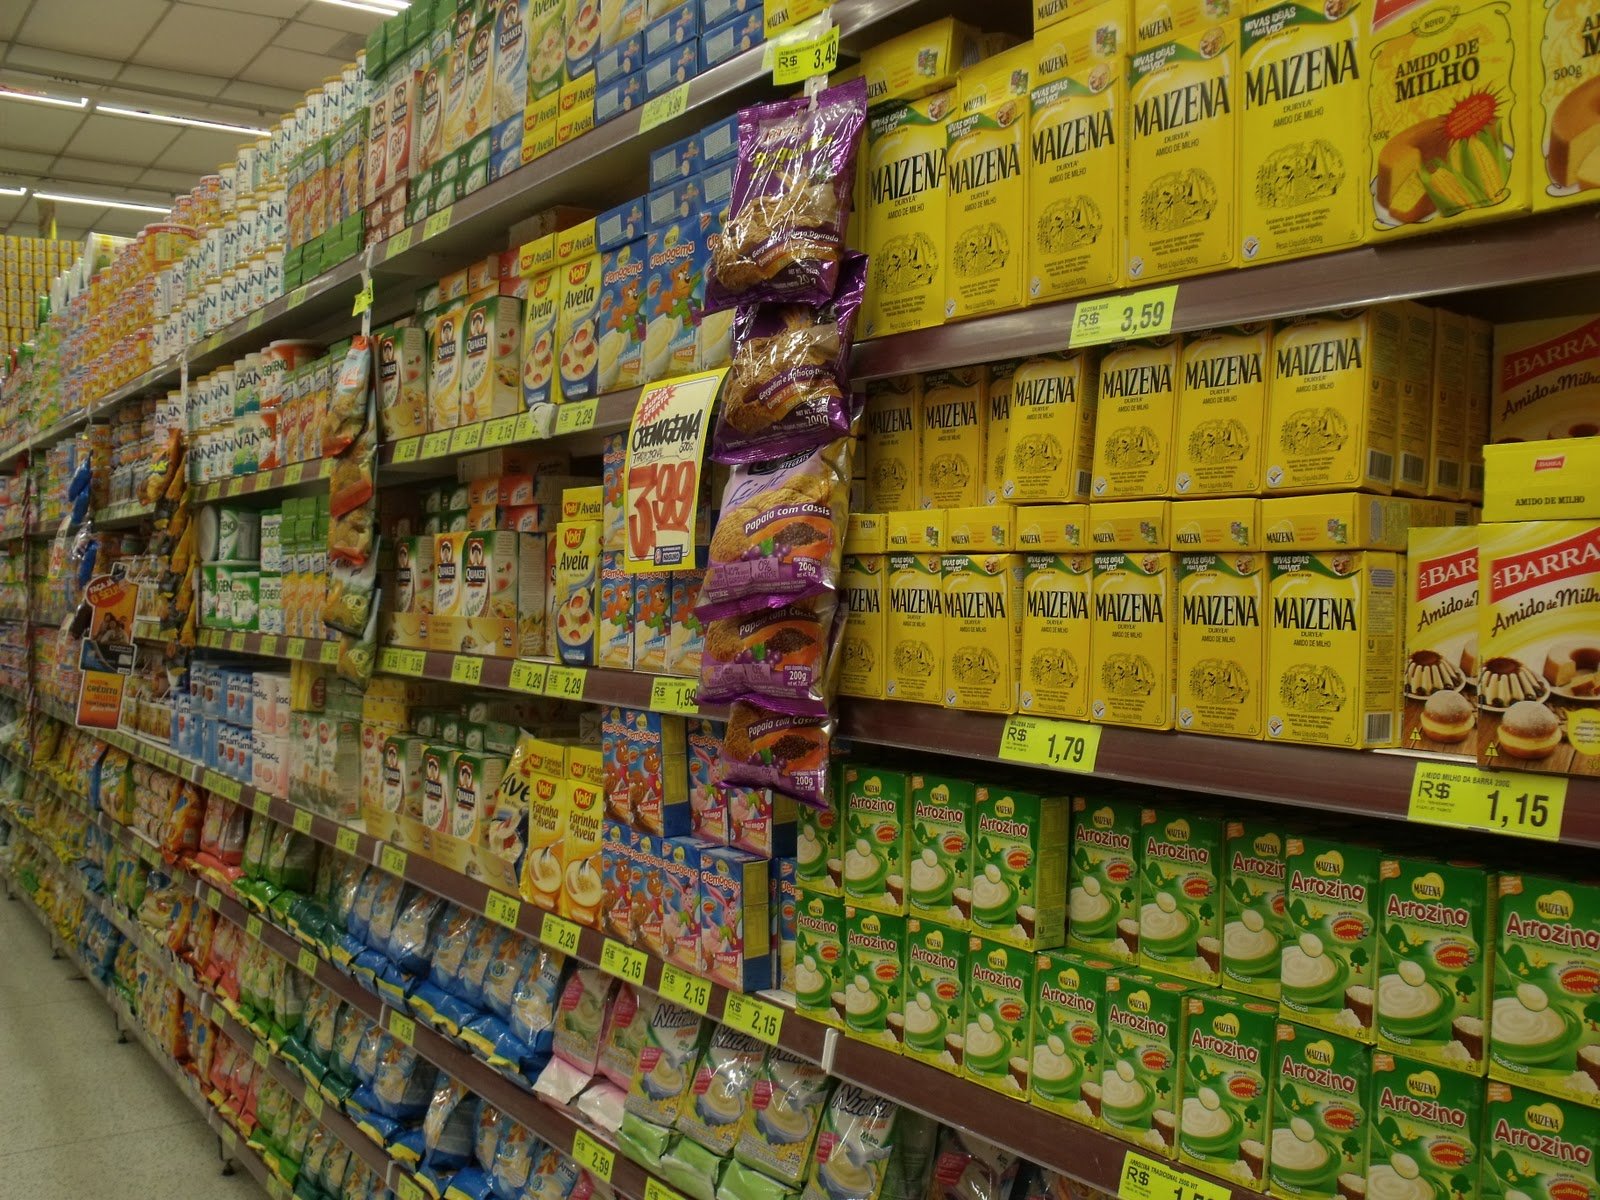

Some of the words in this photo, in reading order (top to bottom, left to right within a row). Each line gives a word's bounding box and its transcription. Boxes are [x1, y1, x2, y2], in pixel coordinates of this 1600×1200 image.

[767, 8, 789, 29] MAIZENA
[1138, 17, 1172, 41] MAIZENA
[500, 27, 522, 46] QUAKER
[469, 51, 488, 70] QUAKER
[779, 56, 797, 68] R$
[814, 41, 836, 69] 3,49
[1038, 54, 1068, 76] MAIZENA
[1395, 46, 1451, 79] AMIDO
[1454, 38, 1479, 62] DE
[1246, 38, 1360, 110] MAIZENA
[1395, 56, 1480, 103] MILHO
[1553, 63, 1583, 82] 500g
[538, 107, 557, 123] Aveia
[1133, 75, 1230, 140] MAIZENA
[1272, 113, 1292, 128] AMIDO
[1293, 113, 1302, 123] DE
[1304, 107, 1324, 120] MILHO
[573, 116, 592, 132] Aveia
[536, 136, 554, 153] Aveia
[1032, 108, 1115, 168] MAIZENA
[1372, 129, 1390, 142] 500g
[870, 147, 948, 207] MAIZENA
[949, 143, 1021, 197] MAIZENA
[574, 235, 593, 251] Aveia
[534, 250, 552, 264] Aveia
[563, 286, 594, 311] Aveia
[529, 300, 552, 322] Aveia
[1078, 312, 1100, 328] R$
[1120, 300, 1165, 334] 3,59
[467, 334, 487, 352] QUAKER
[1276, 337, 1362, 379] MAIZENA
[1512, 332, 1592, 379] BARRA
[1102, 365, 1172, 399] MAIZENA
[1185, 352, 1263, 392] MAIZENA
[1015, 376, 1075, 407] MAIZENA
[1501, 386, 1549, 422] Amido
[575, 408, 593, 427] 2,29
[806, 415, 829, 427] 200g
[869, 407, 912, 435] MAIZENA
[925, 401, 977, 430] MAIZENA
[498, 425, 512, 440] 2,15
[632, 409, 703, 452] CREMOGEMA
[580, 502, 601, 515] Aveia
[1515, 498, 1543, 506] AMIDO
[1544, 497, 1556, 505] DE
[1558, 496, 1585, 504] MILHO
[745, 511, 774, 533] Papaia
[778, 507, 798, 515] com
[802, 504, 830, 515] Cassis
[890, 533, 908, 545] MAIZENA
[951, 533, 970, 545] MAIZENA
[1020, 532, 1041, 544] MAIZENA
[1092, 532, 1115, 543] MAIZENA
[1176, 532, 1201, 544] MAIZENA
[1266, 531, 1294, 544] MAIZENA
[559, 551, 589, 571] Aveia
[758, 561, 771, 572] 0%
[798, 562, 816, 573] 200g
[1428, 557, 1478, 586] BAR
[1503, 545, 1600, 588] BARRA
[466, 567, 486, 582] QUAKER
[890, 589, 942, 614] MAIZENA
[944, 592, 1005, 619] MAIZENA
[1026, 590, 1089, 619] MAIZENA
[1095, 593, 1164, 623] MAIZENA
[1182, 595, 1259, 627] MAIZENA
[1273, 597, 1357, 631] MAIZENA
[1417, 600, 1463, 632] Amido
[1463, 598, 1474, 608] de
[1491, 600, 1545, 638] Amido
[1546, 600, 1558, 611] de
[1293, 639, 1309, 647] AMIDO
[1316, 640, 1331, 648] MILHO
[465, 665, 479, 680] 2,15
[525, 672, 542, 688] 2,29
[789, 670, 807, 681] 200g
[564, 677, 581, 695] 2,29
[654, 687, 665, 697] R$
[748, 720, 773, 737] Papaia
[1006, 727, 1027, 742] R$
[1048, 734, 1085, 763] 1,79
[500, 773, 529, 798] Ave
[795, 776, 813, 785] 200g
[457, 789, 475, 802] QUAKER
[574, 789, 593, 808] Yoki
[850, 794, 896, 813] Arrozina
[1418, 780, 1451, 800] R$
[1486, 789, 1549, 829] 1,15
[532, 802, 559, 819] Farinha
[569, 811, 599, 830] Farinha
[915, 801, 963, 823] Arrozina
[537, 816, 556, 831] Aveia
[575, 827, 596, 842] Aveia
[979, 813, 1028, 838] Arrozina
[1076, 824, 1130, 850] Arrozina
[1147, 838, 1210, 865] Arrozina
[1255, 844, 1279, 856] MAIZENA
[1315, 858, 1341, 875] MAIZENA
[1291, 870, 1366, 902] Arrozina
[1413, 883, 1441, 899] MAIZENA
[500, 906, 516, 923] 3,99
[1387, 894, 1470, 927] Arrozina
[1537, 902, 1570, 920] MAIZENA
[798, 912, 837, 935] Arrozina
[1506, 912, 1600, 949] Arrozina
[558, 930, 576, 949] 2,29
[848, 929, 897, 951] Arrozina
[604, 948, 616, 960] R$
[622, 957, 641, 979] 2,15
[911, 945, 957, 970] Arrozina
[973, 963, 1023, 990] Arrozina
[1059, 976, 1079, 989] MAIZENA
[663, 973, 676, 984] R$
[684, 982, 706, 1006] 2,15
[1041, 983, 1095, 1013] Arrozina
[1128, 998, 1150, 1012] MAIZENA
[728, 1000, 742, 1013] R$
[751, 1010, 776, 1036] 2,15
[1110, 1004, 1168, 1037] Arrozina
[1214, 1021, 1239, 1035] MAIZENA
[1192, 1028, 1259, 1063] Arrozina
[1305, 1047, 1333, 1063] MAIZENA
[1282, 1056, 1357, 1094] Arrozina
[1491, 1054, 1530, 1074] Tradicional
[1408, 1079, 1439, 1095] MAIZENA
[1379, 1088, 1465, 1128] Arrozina
[1528, 1112, 1561, 1130] MAIZENA
[1494, 1119, 1592, 1166] Arrozina
[591, 1151, 609, 1175] 2,59
[1126, 1166, 1150, 1187] R$
